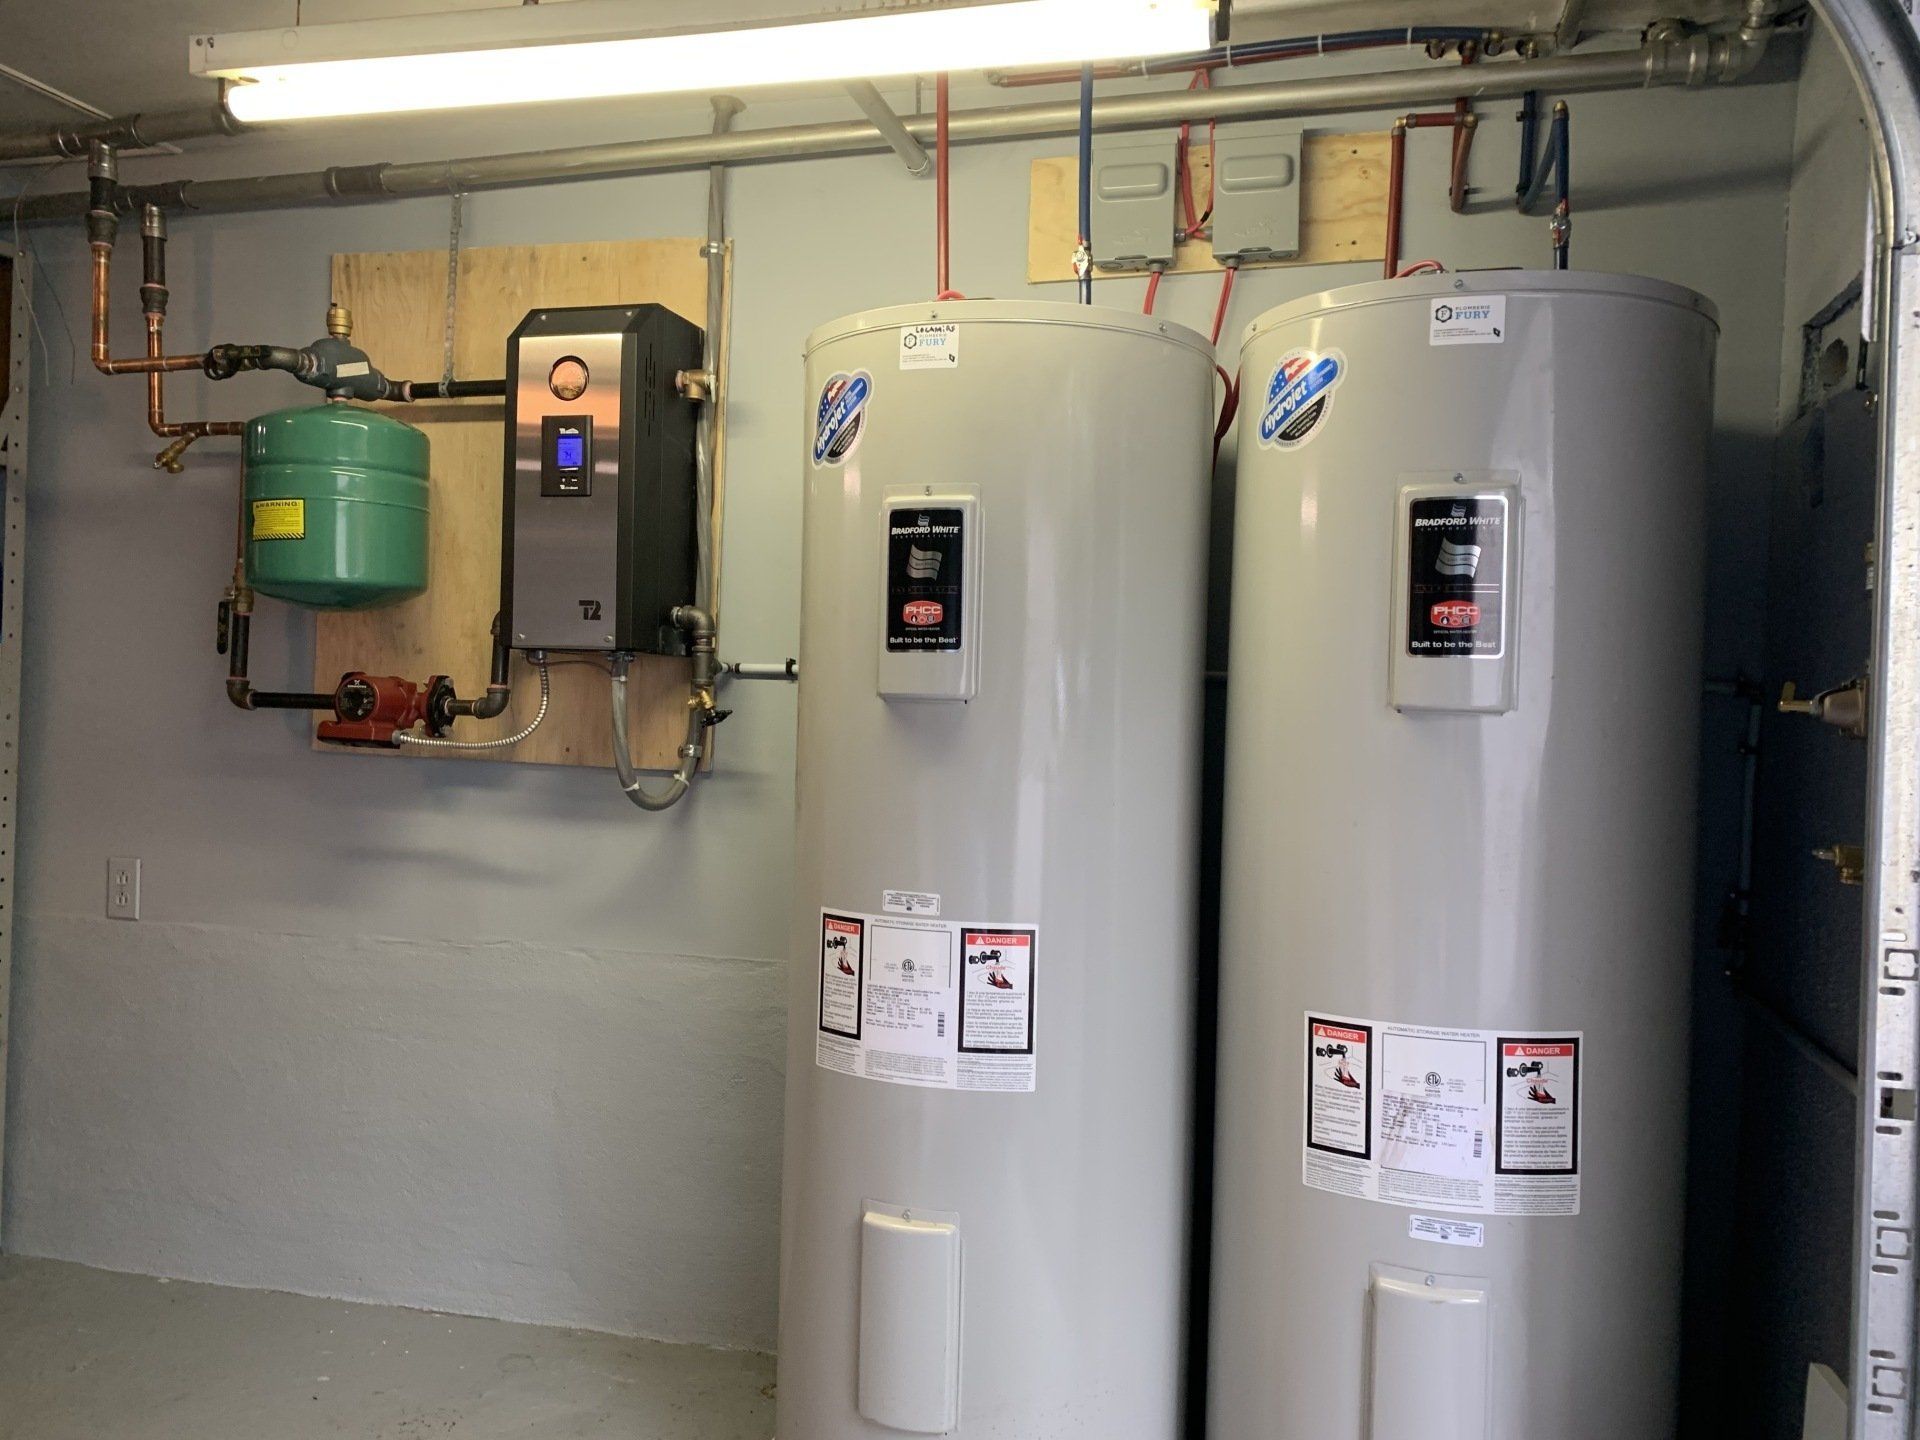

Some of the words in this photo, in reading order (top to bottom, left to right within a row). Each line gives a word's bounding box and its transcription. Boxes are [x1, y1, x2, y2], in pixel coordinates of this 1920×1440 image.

[1455, 311, 1490, 319] FURY
[919, 338, 945, 346] FURY
[1264, 381, 1307, 432] Hydrojet
[1415, 518, 1467, 527] BRADFORD
[1469, 517, 1501, 525] WHITE
[891, 526, 931, 535] BRADFORD
[932, 525, 960, 533] WHITE
[579, 600, 601, 620] T2
[905, 606, 941, 614] PHCC
[1433, 606, 1479, 615] PHCC
[1327, 1029, 1359, 1040] DANGER
